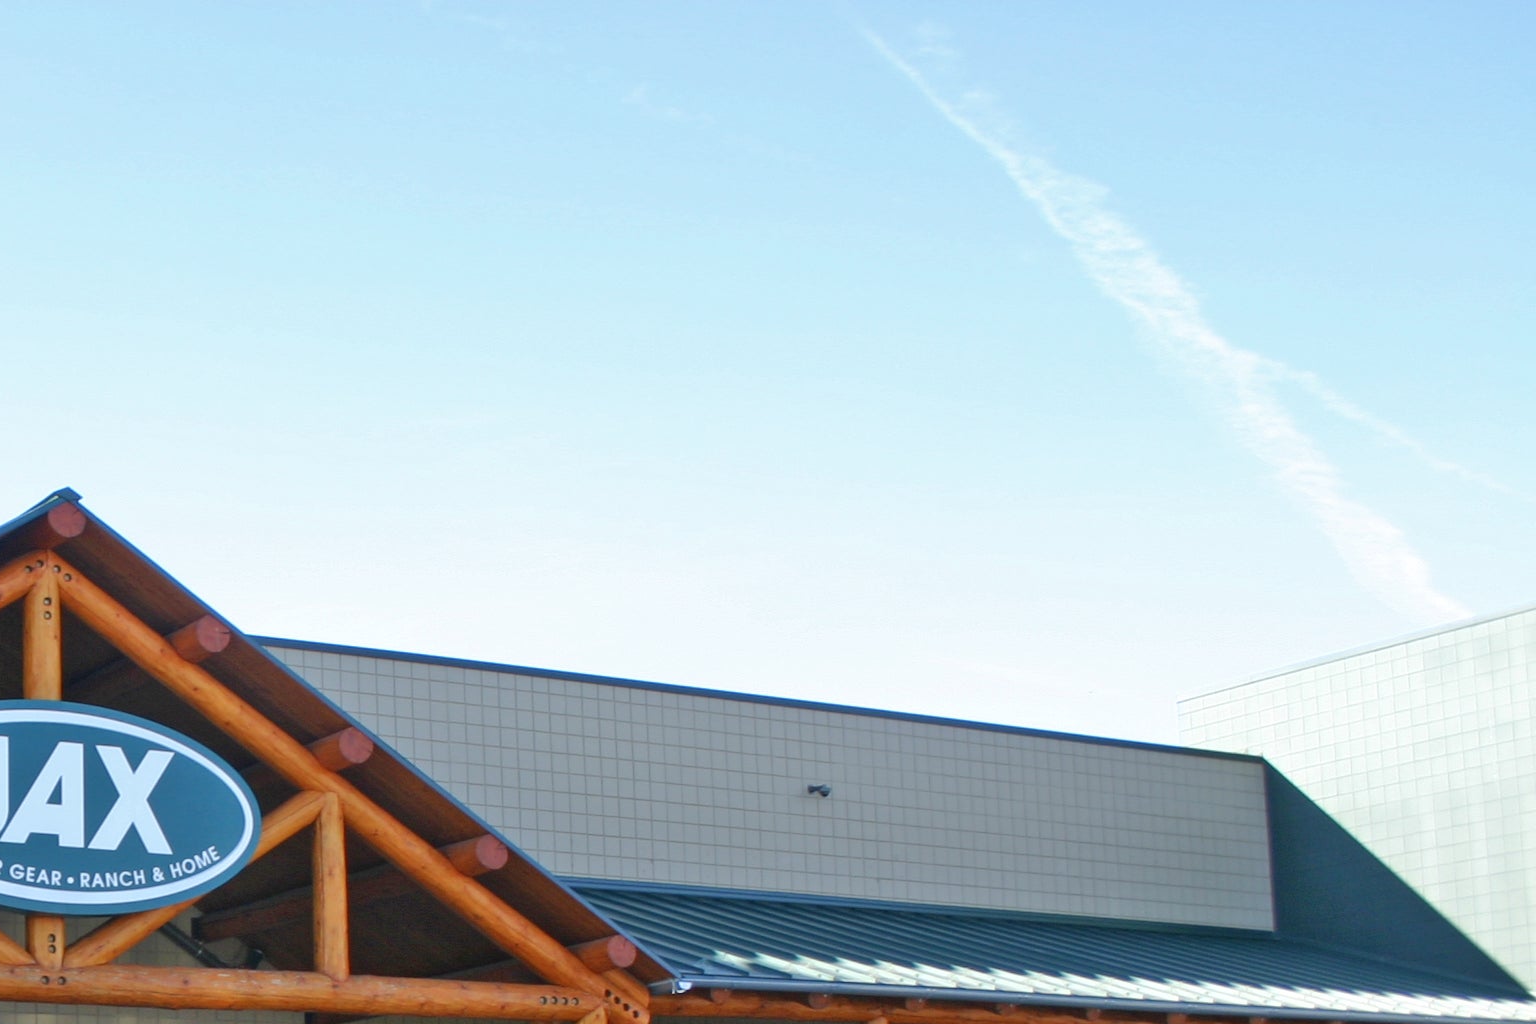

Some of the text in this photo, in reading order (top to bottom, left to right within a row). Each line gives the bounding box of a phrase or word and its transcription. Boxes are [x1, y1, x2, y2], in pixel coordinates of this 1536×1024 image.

[9, 863, 63, 887] GEAR
[79, 869, 146, 888] RANCH
[152, 866, 165, 883] &
[169, 845, 221, 879] HOME
